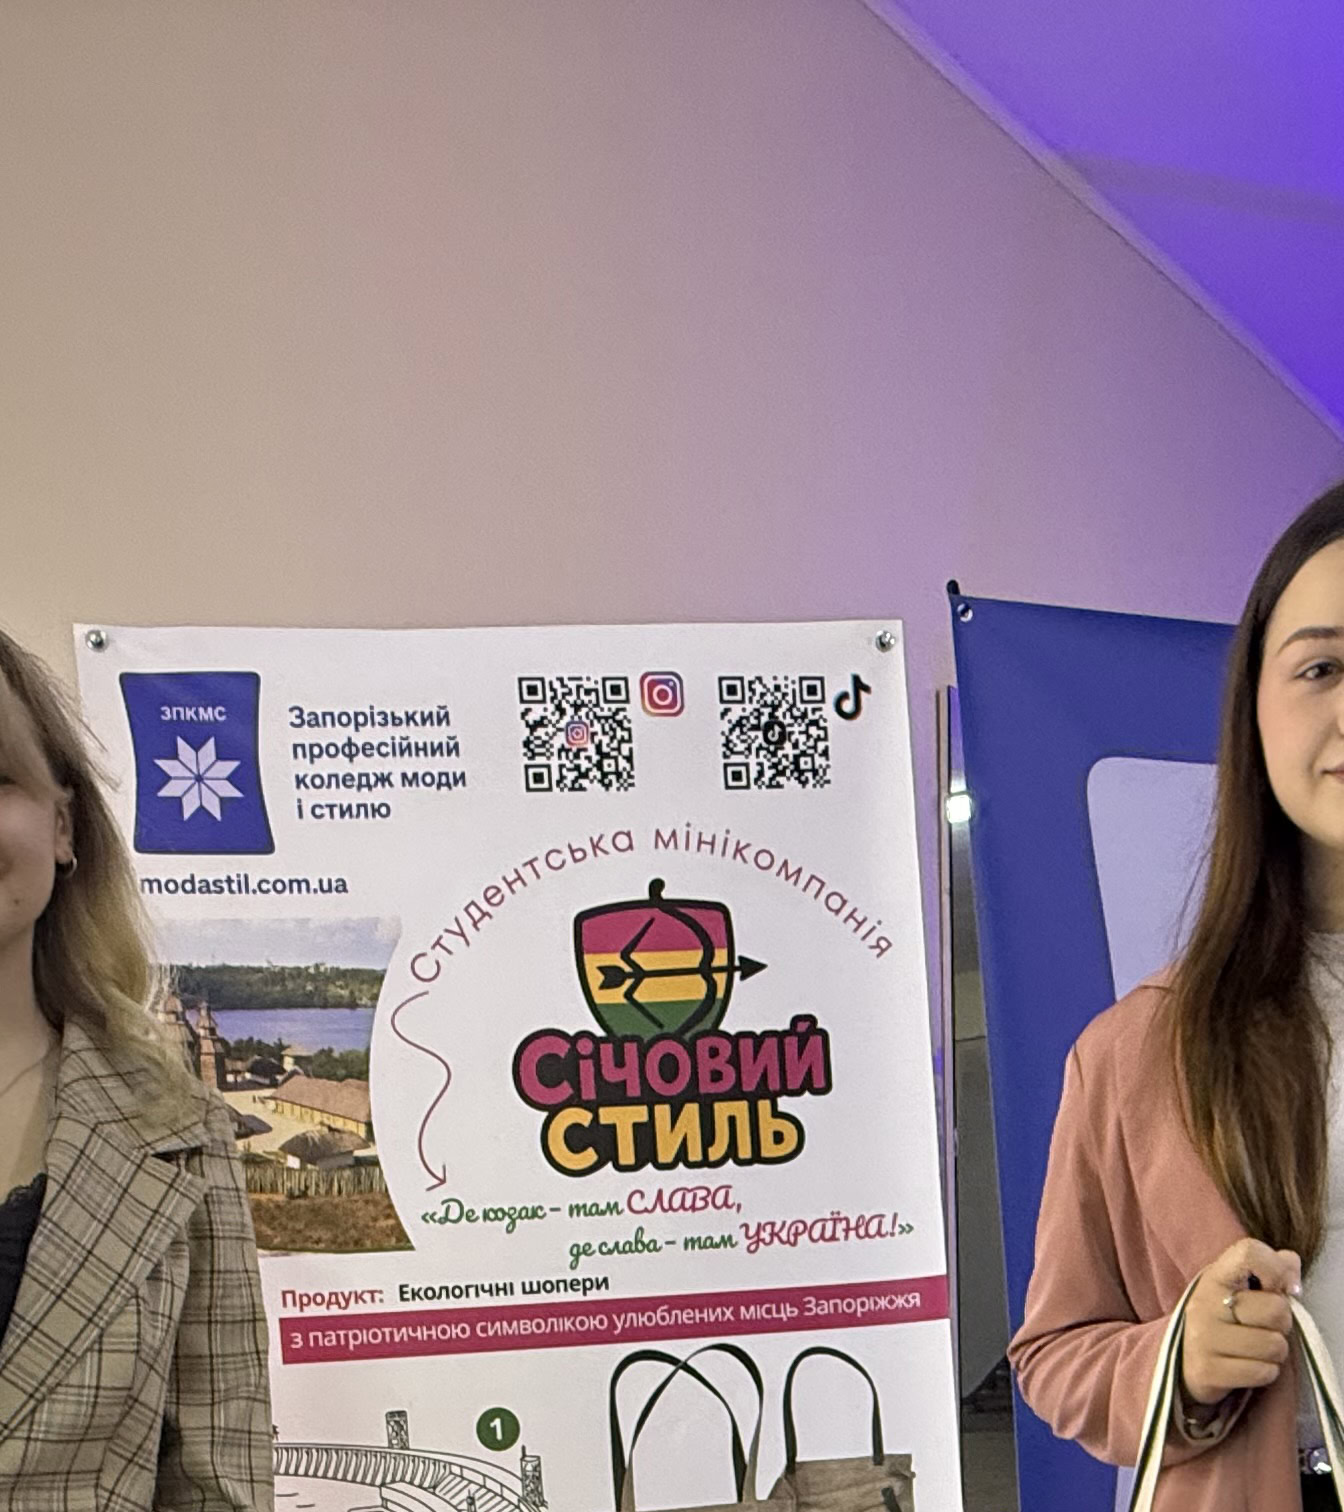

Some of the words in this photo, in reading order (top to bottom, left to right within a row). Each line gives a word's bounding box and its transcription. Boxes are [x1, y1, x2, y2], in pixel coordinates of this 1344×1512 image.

[161, 706, 226, 722] ЗПКМС
[288, 706, 450, 731] Запорізький
[292, 736, 460, 763] професійний
[295, 770, 394, 792] коледж
[401, 770, 466, 792] моди
[310, 801, 391, 820] стилю
[141, 873, 348, 895] modastil.com.ua
[410, 829, 634, 983] Студентська
[655, 822, 893, 959] мінікомпанія
[568, 1203, 622, 1219] там
[570, 1243, 596, 1269] де
[598, 1226, 662, 1255] слава
[683, 1232, 738, 1252] там
[281, 1289, 384, 1314] Продукт:
[399, 1282, 514, 1302] Екологічні
[521, 1276, 609, 1299] шопери
[290, 1333, 304, 1348] з
[308, 1323, 471, 1350] патріотичною
[476, 1313, 608, 1337] символікою
[614, 1306, 734, 1334] улюблених
[740, 1302, 798, 1324] місць
[804, 1289, 920, 1318] Запоріжжя
[490, 1417, 504, 1441] 1
